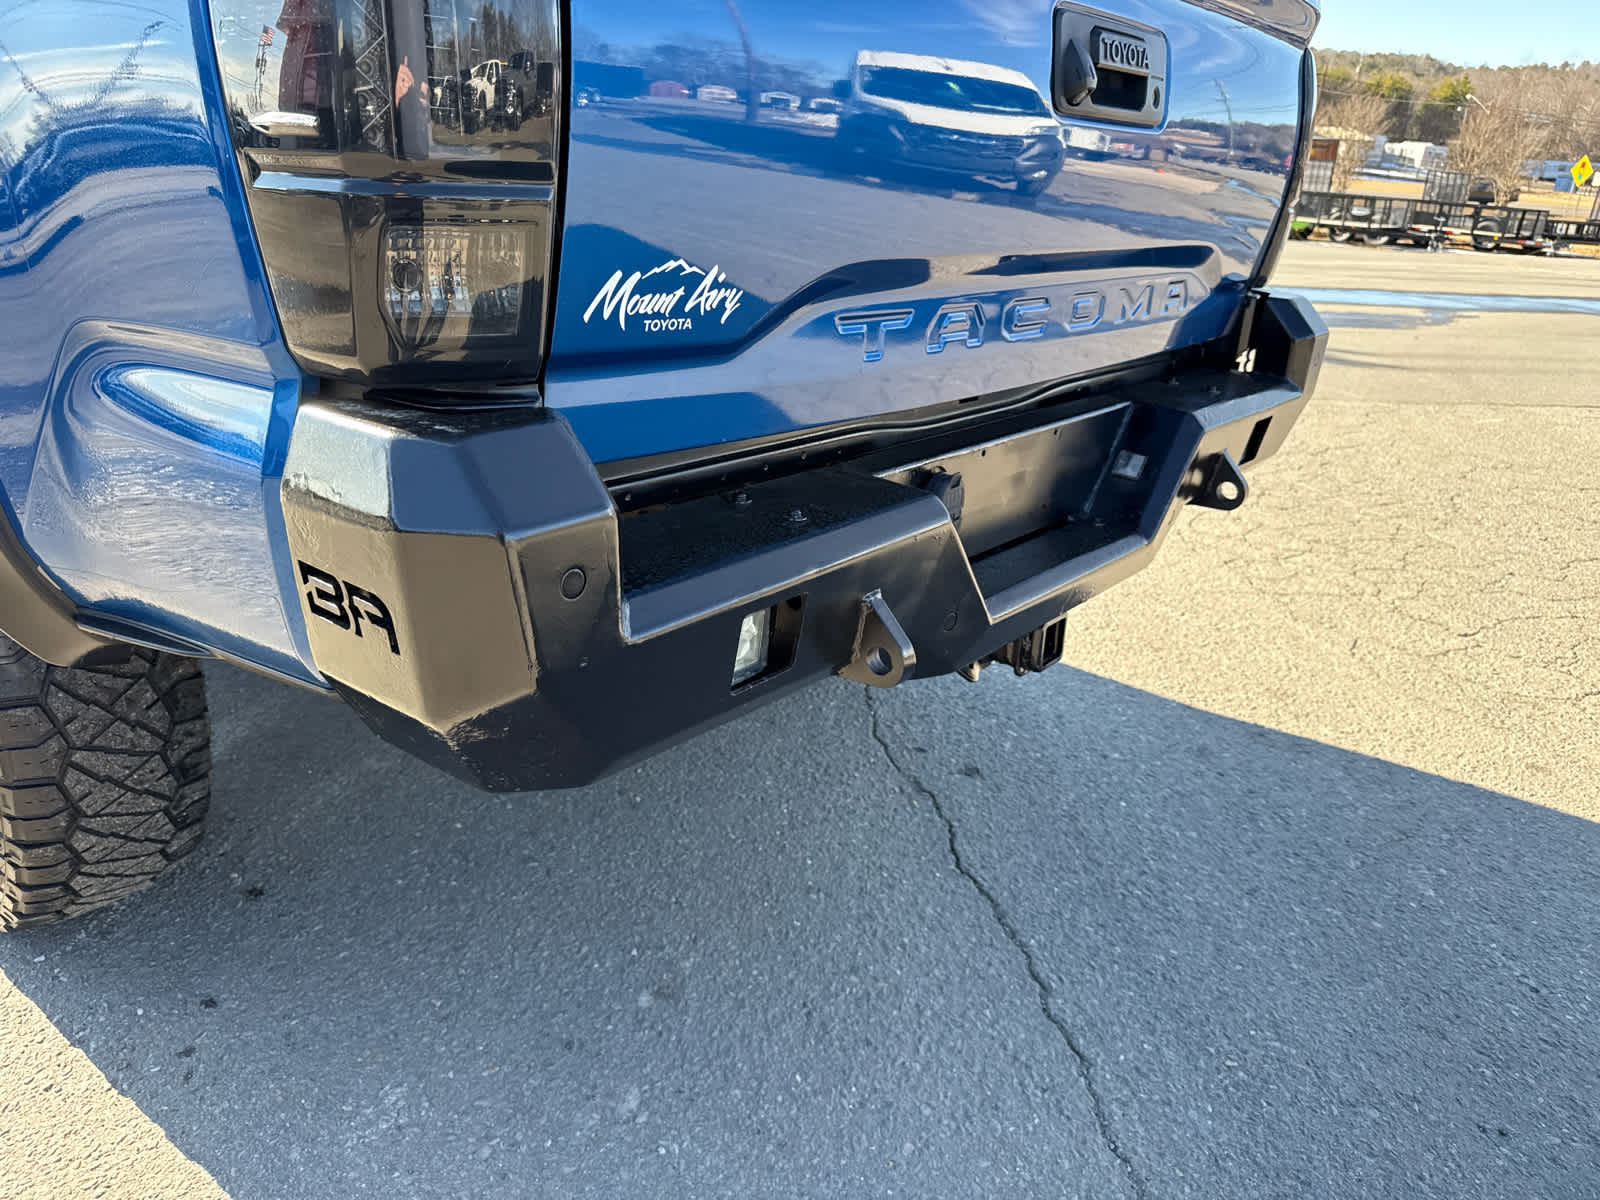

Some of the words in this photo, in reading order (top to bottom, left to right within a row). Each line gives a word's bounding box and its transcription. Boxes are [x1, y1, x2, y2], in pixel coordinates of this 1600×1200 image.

[1102, 37, 1149, 69] TOYOTA
[583, 269, 685, 331] Mount
[684, 264, 743, 325] Airy
[834, 279, 1193, 362] TACOMA
[643, 318, 692, 332] TOYOTA
